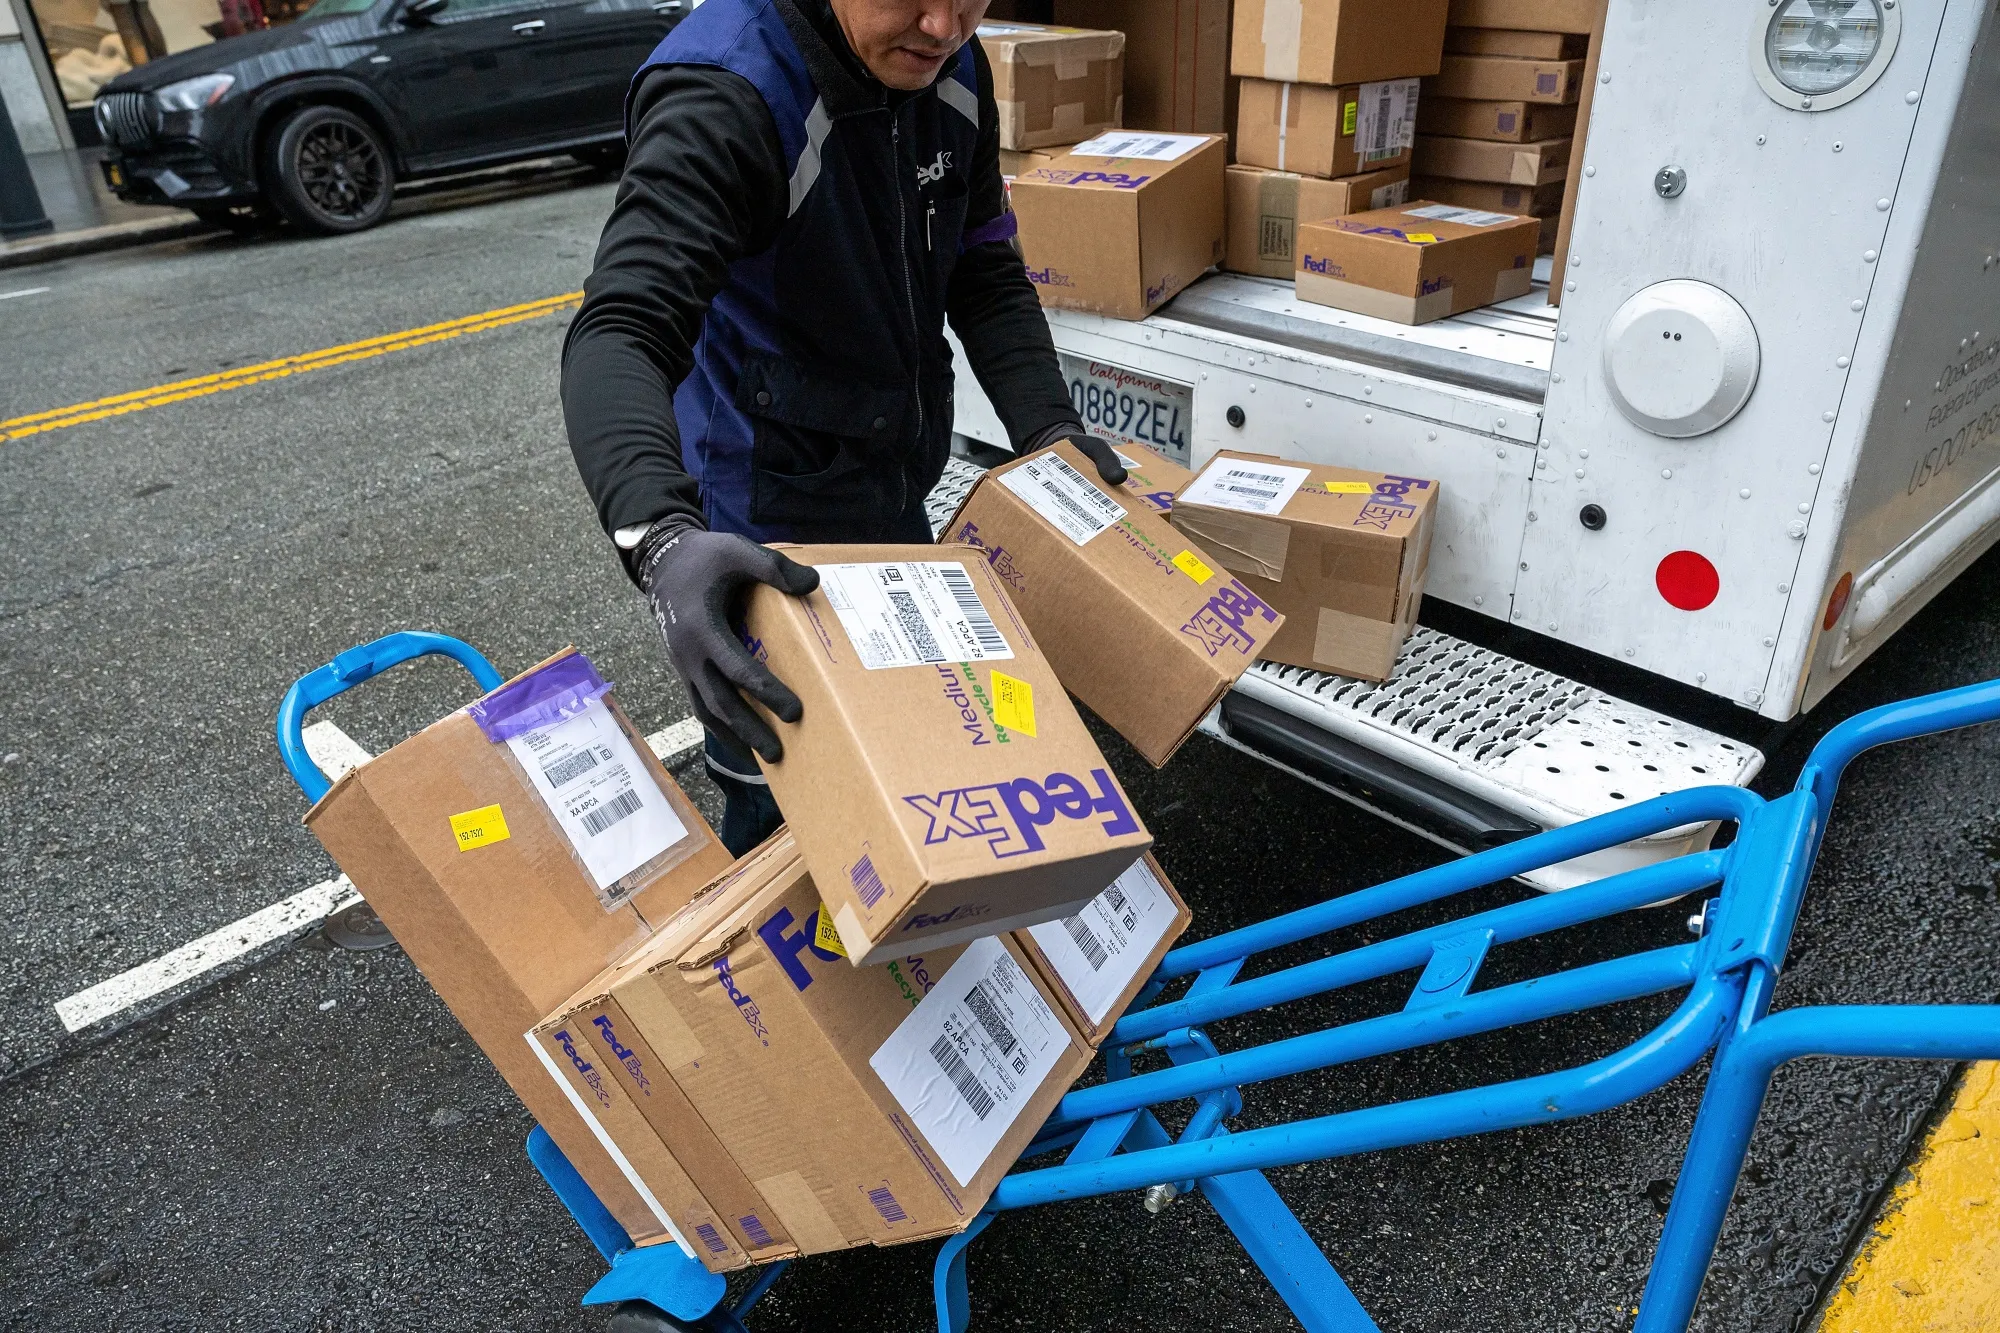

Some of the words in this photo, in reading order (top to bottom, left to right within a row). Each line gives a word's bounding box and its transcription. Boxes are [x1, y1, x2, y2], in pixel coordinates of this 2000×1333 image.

[1304, 255, 1346, 278] FedEx
[1089, 361, 1171, 396] California
[1071, 378, 1184, 451] 08892E4
[1081, 490, 1104, 510] APCA
[1353, 475, 1430, 530] FedEx
[955, 619, 976, 645] APCA
[1180, 578, 1278, 657] FedEx
[970, 647, 984, 658] 82
[569, 805, 582, 818] XA
[578, 795, 599, 812] APCA
[902, 769, 1140, 859] FedEx
[713, 956, 768, 1038] FedEx
[592, 1014, 650, 1089] FedEx
[941, 1019, 955, 1033] 82
[949, 1030, 972, 1056] APCA
[554, 1030, 610, 1101] FedEx
